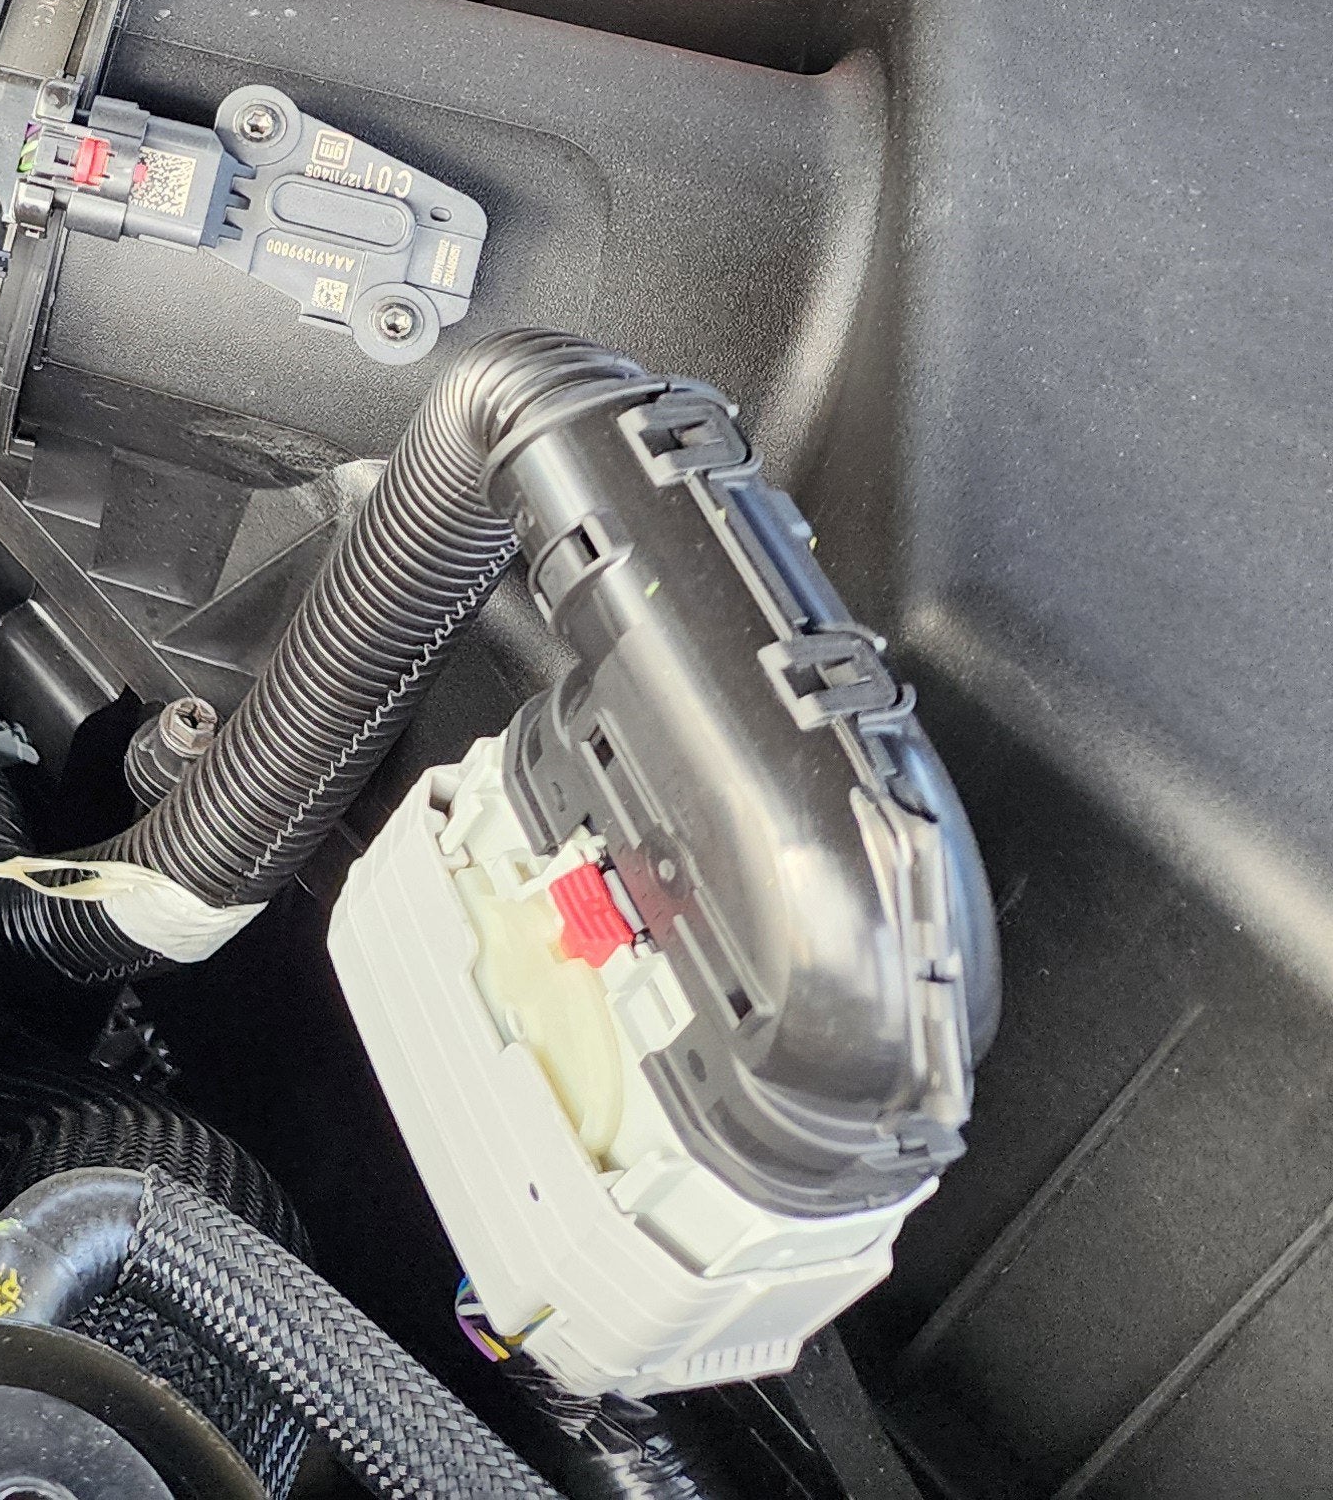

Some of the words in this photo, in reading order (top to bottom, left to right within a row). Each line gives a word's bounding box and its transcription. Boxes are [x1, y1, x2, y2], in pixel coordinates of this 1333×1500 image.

[319, 138, 346, 161] gm
[304, 163, 366, 185] 12711405
[367, 161, 413, 198] C01
